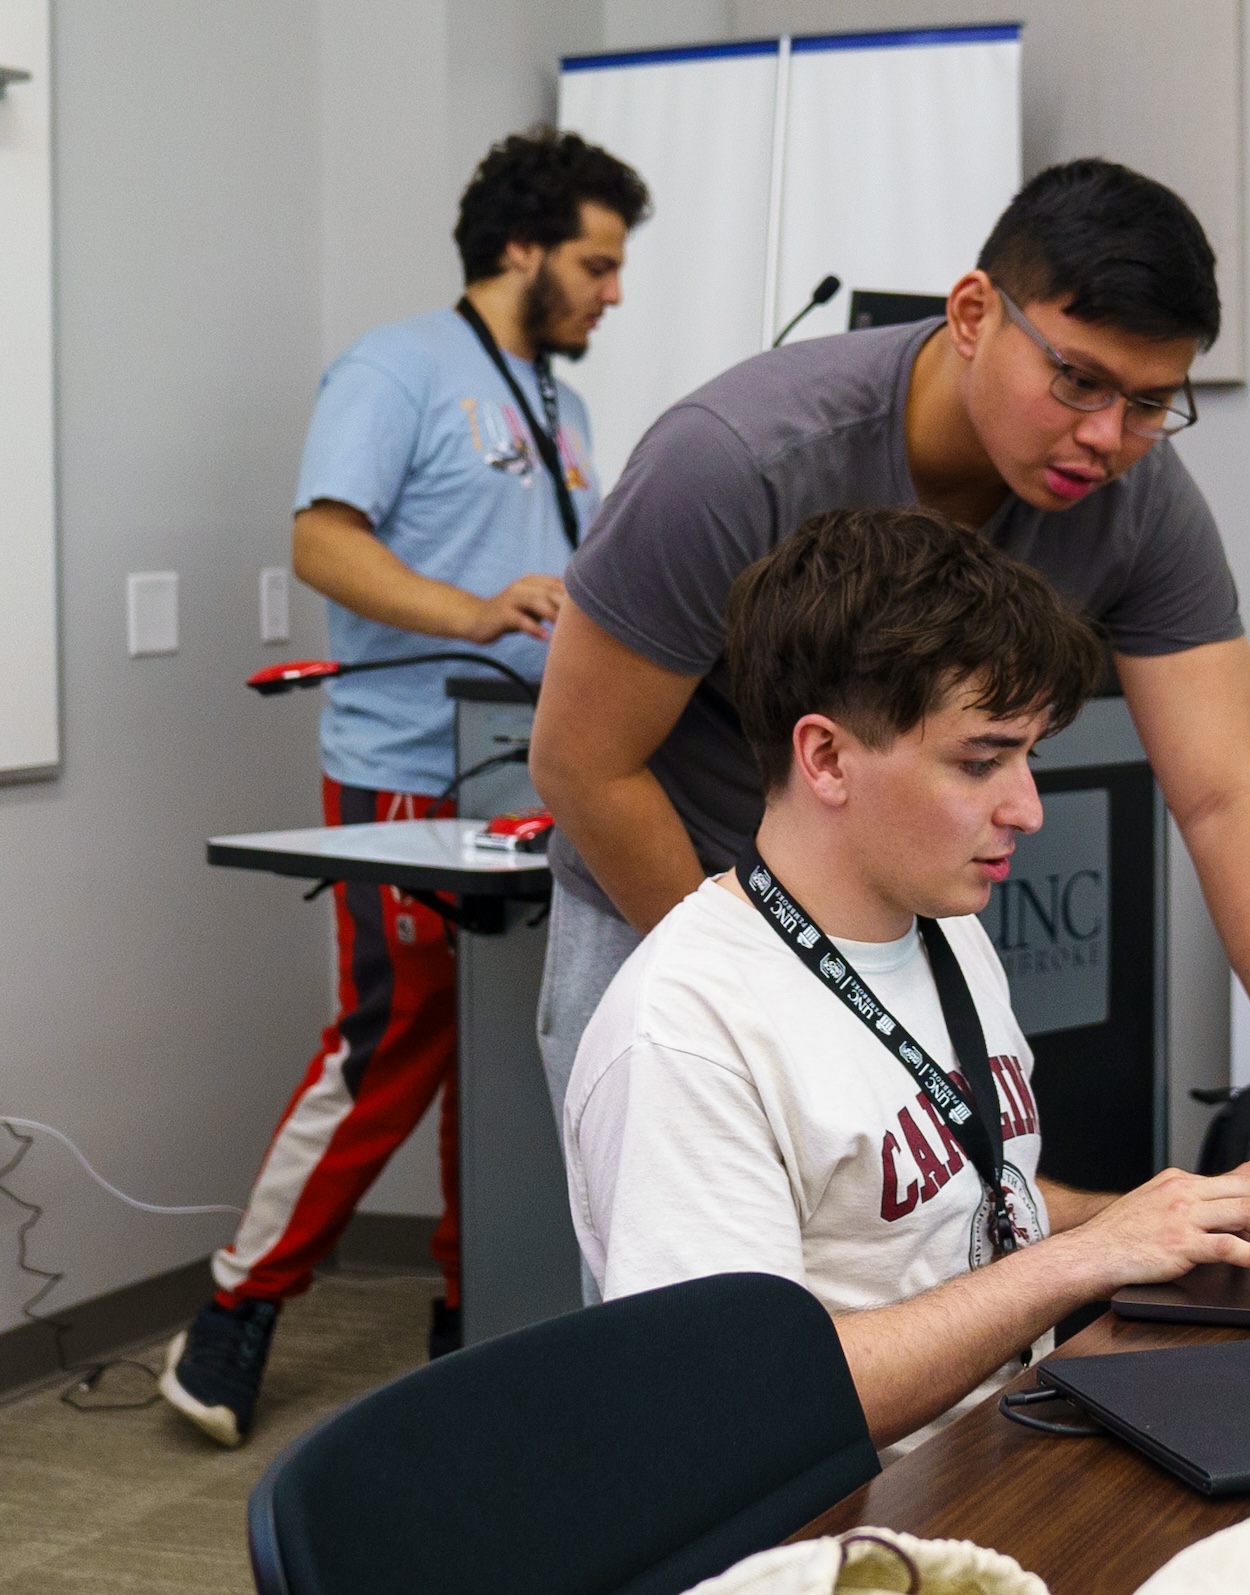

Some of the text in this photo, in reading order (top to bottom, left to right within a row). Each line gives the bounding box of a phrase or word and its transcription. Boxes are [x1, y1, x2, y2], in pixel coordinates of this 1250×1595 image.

[769, 900, 798, 935] UNC
[775, 890, 809, 928] PEMBROKE
[993, 869, 1102, 950] NC
[846, 989, 875, 1020] UNC
[924, 1076, 951, 1109] UNC
